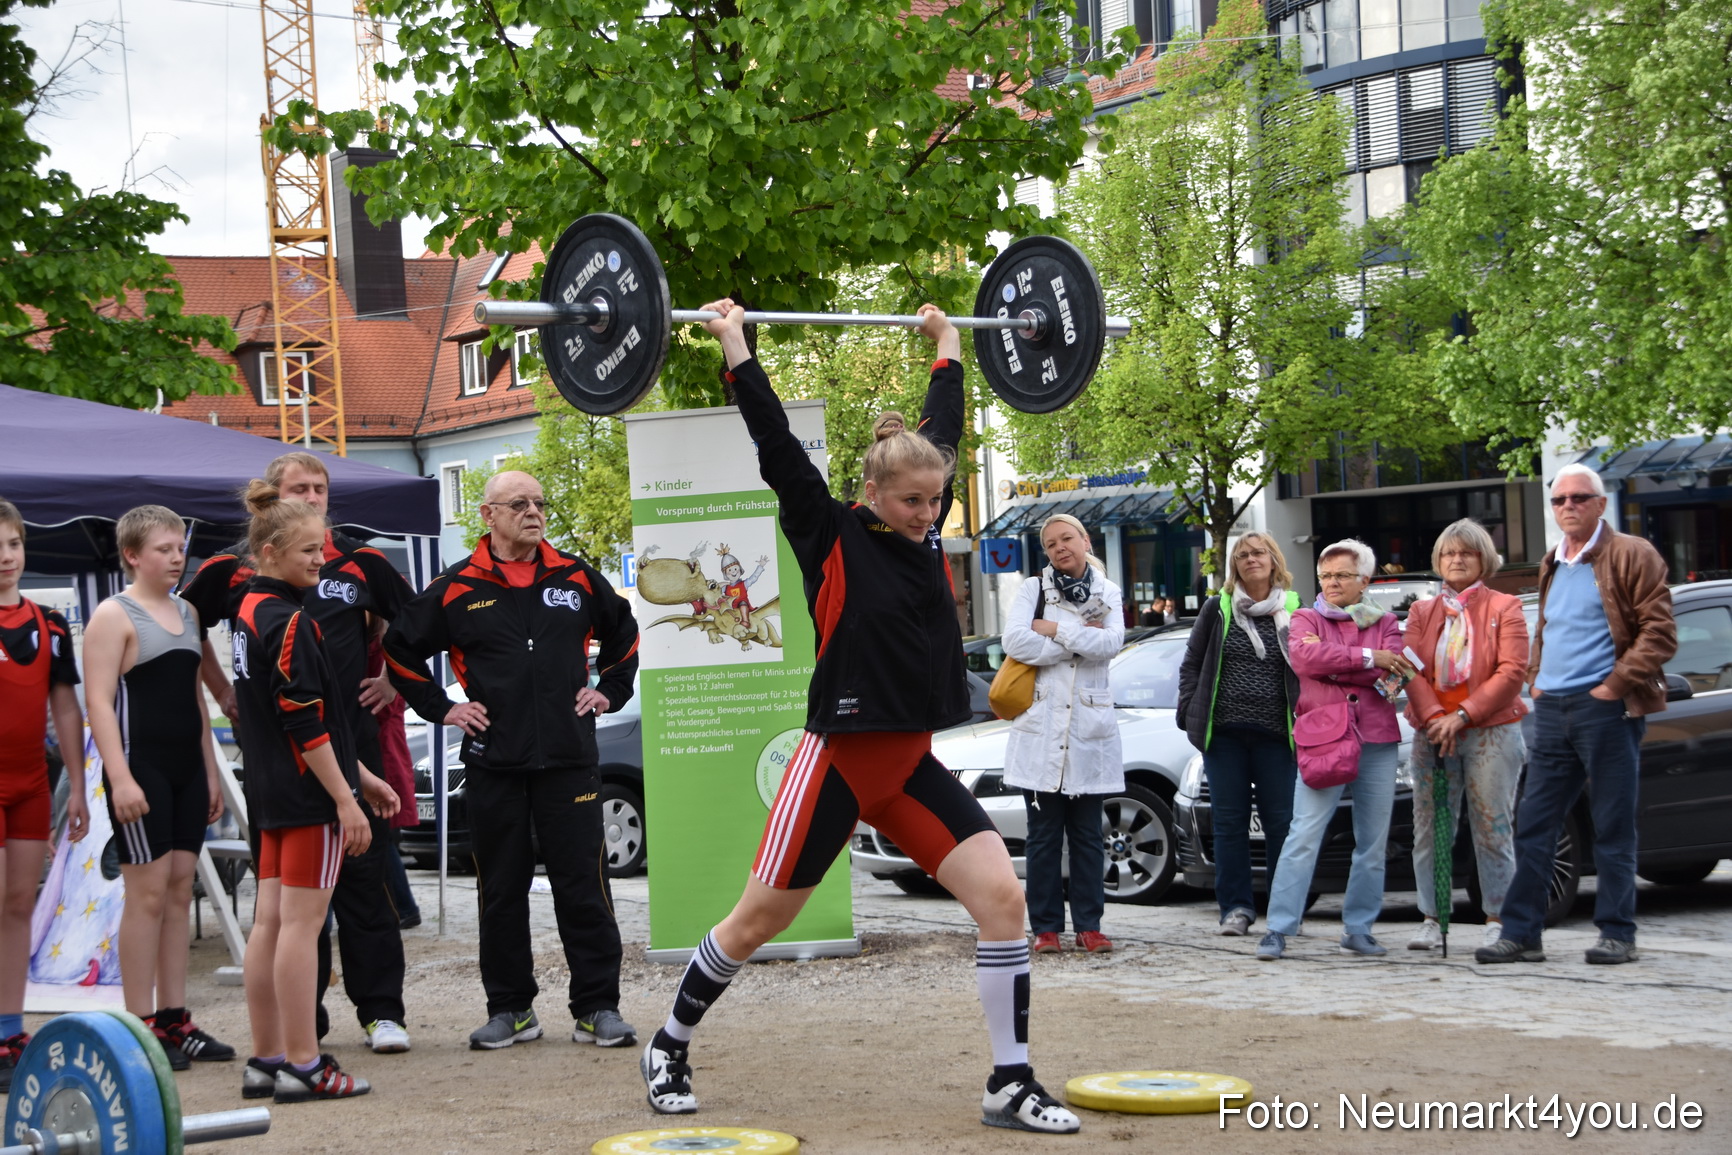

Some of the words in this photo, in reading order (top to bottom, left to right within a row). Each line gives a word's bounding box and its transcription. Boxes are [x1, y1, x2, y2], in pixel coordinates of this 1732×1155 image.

[562, 252, 606, 304] ELEIKO
[1050, 276, 1076, 346] ELEIKO
[595, 325, 642, 381] ELEIKO
[655, 479, 692, 491] Kinder
[1016, 480, 1040, 498] City
[1042, 478, 1080, 493] Center
[656, 505, 704, 517] Vorsprung
[707, 502, 732, 512] durch
[736, 500, 780, 510] Frühstart
[467, 599, 497, 611] saller
[664, 674, 694, 683] Spielend
[697, 670, 725, 681] Englisch
[728, 670, 750, 678] lernen
[752, 669, 763, 677] für
[765, 668, 784, 676] Minis
[787, 667, 800, 675] und
[710, 682, 734, 690] Jahren
[666, 697, 699, 706] Spezielles
[701, 692, 768, 703] Unterrichtskonzept
[770, 690, 781, 698] für
[666, 709, 685, 718] Spiel,
[688, 707, 715, 716] Gesang,
[718, 705, 755, 714] Bewegung
[774, 702, 792, 711] Spaß
[794, 701, 808, 709] steh
[677, 717, 720, 727] Vordergrund
[667, 729, 734, 740] Muttersprachliches
[661, 747, 671, 755] Fit
[673, 745, 684, 754] für
[687, 745, 698, 753] die
[700, 743, 734, 753] Zukunft!
[48, 1041, 66, 1071] 20
